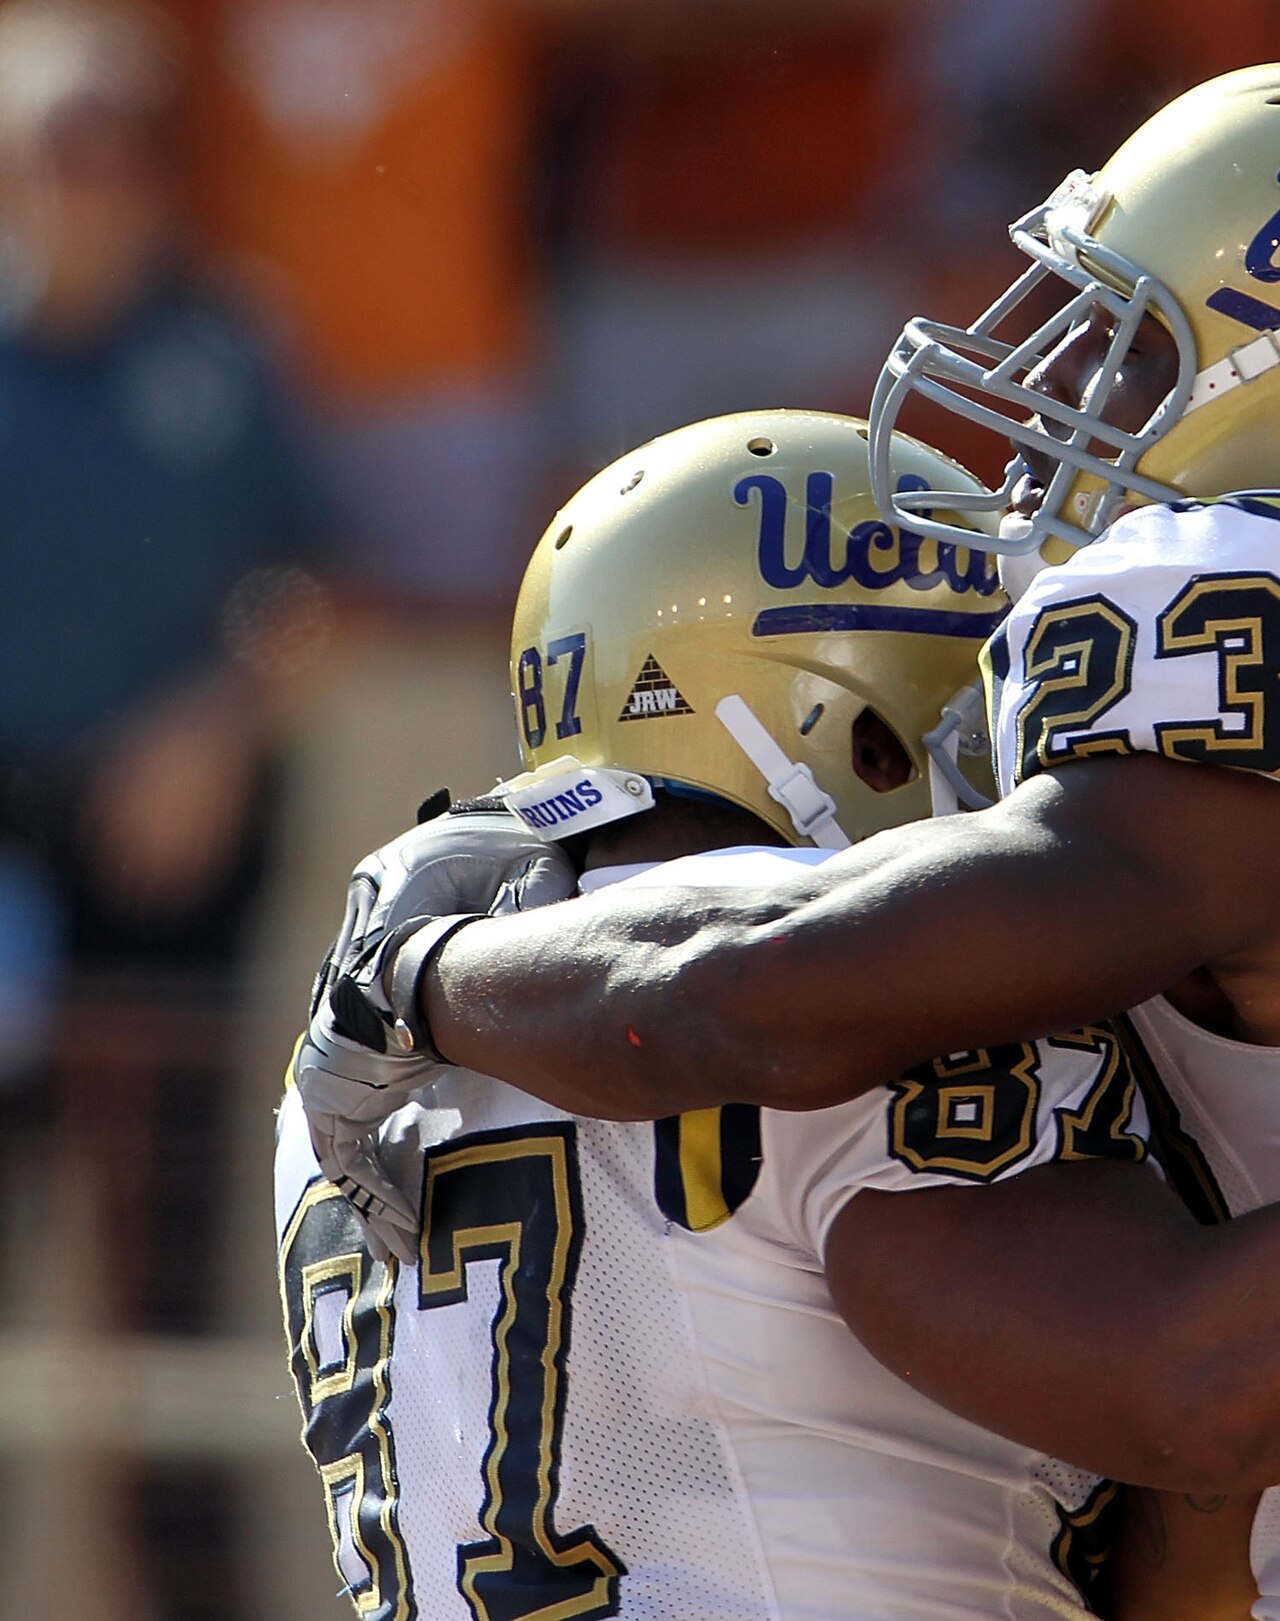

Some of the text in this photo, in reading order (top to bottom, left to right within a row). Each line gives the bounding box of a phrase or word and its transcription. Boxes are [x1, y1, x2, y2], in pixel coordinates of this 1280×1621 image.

[518, 632, 584, 750] 87
[629, 688, 677, 714] JRW
[514, 779, 603, 828] RUINS
[883, 1018, 1149, 1184] 87
[277, 1120, 629, 1621] 87
